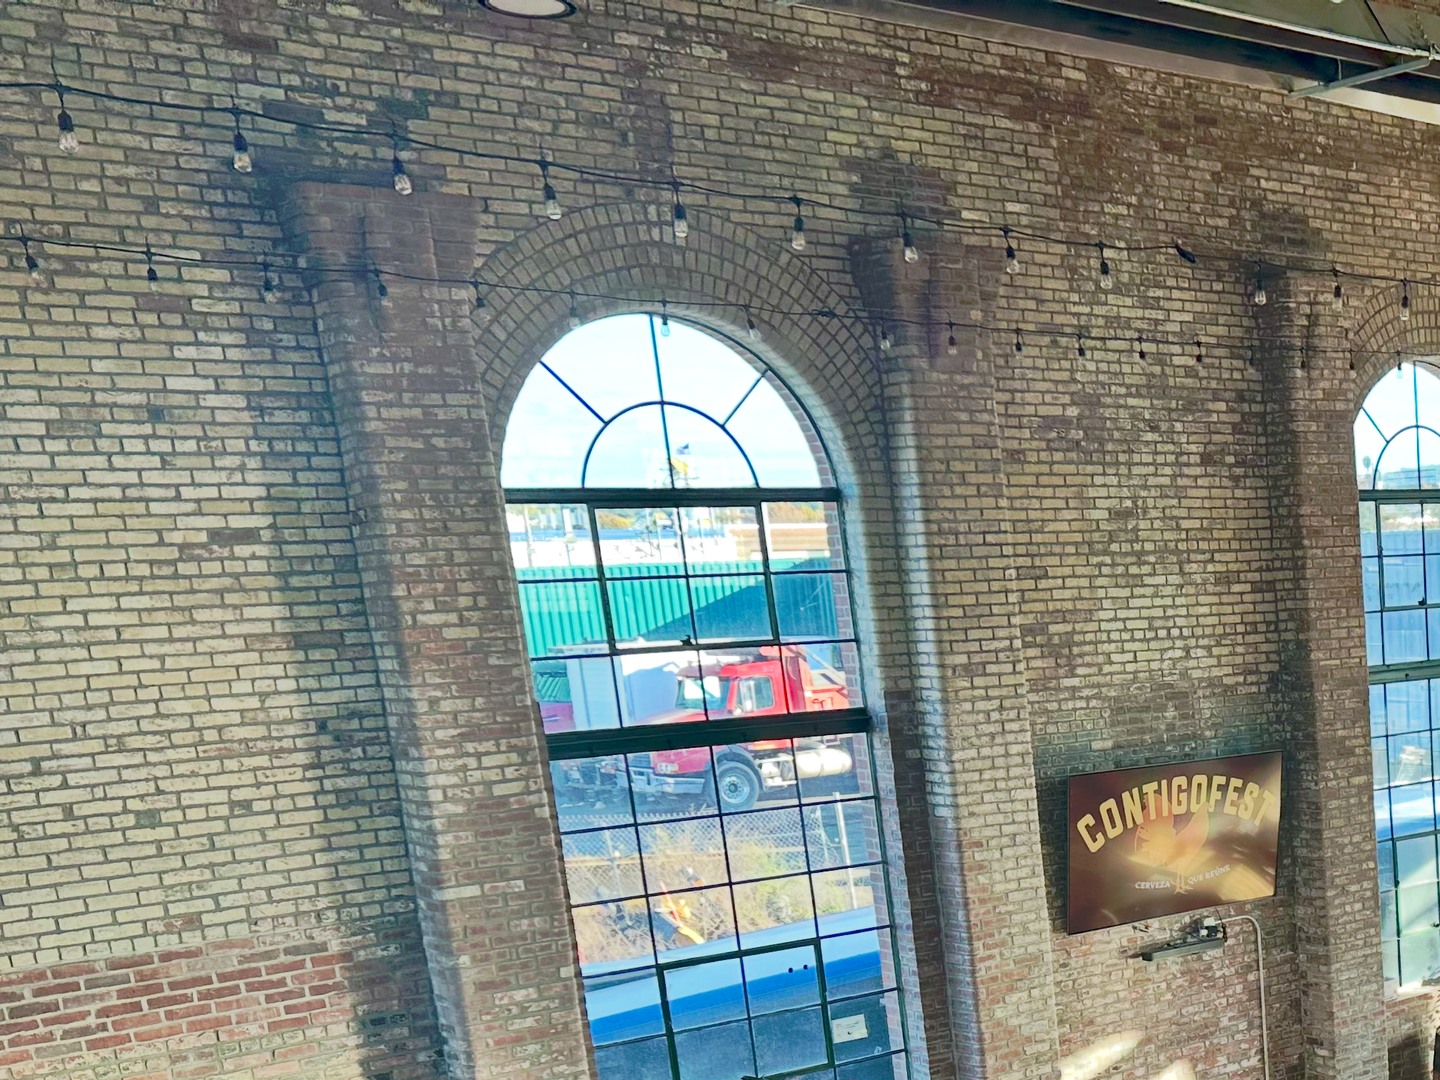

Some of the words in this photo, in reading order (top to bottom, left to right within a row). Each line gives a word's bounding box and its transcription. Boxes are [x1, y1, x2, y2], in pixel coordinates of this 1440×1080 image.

[1076, 774, 1276, 853] CONTIGOFEST
[1134, 880, 1170, 889] CERVEZA
[1187, 874, 1204, 885] QUE
